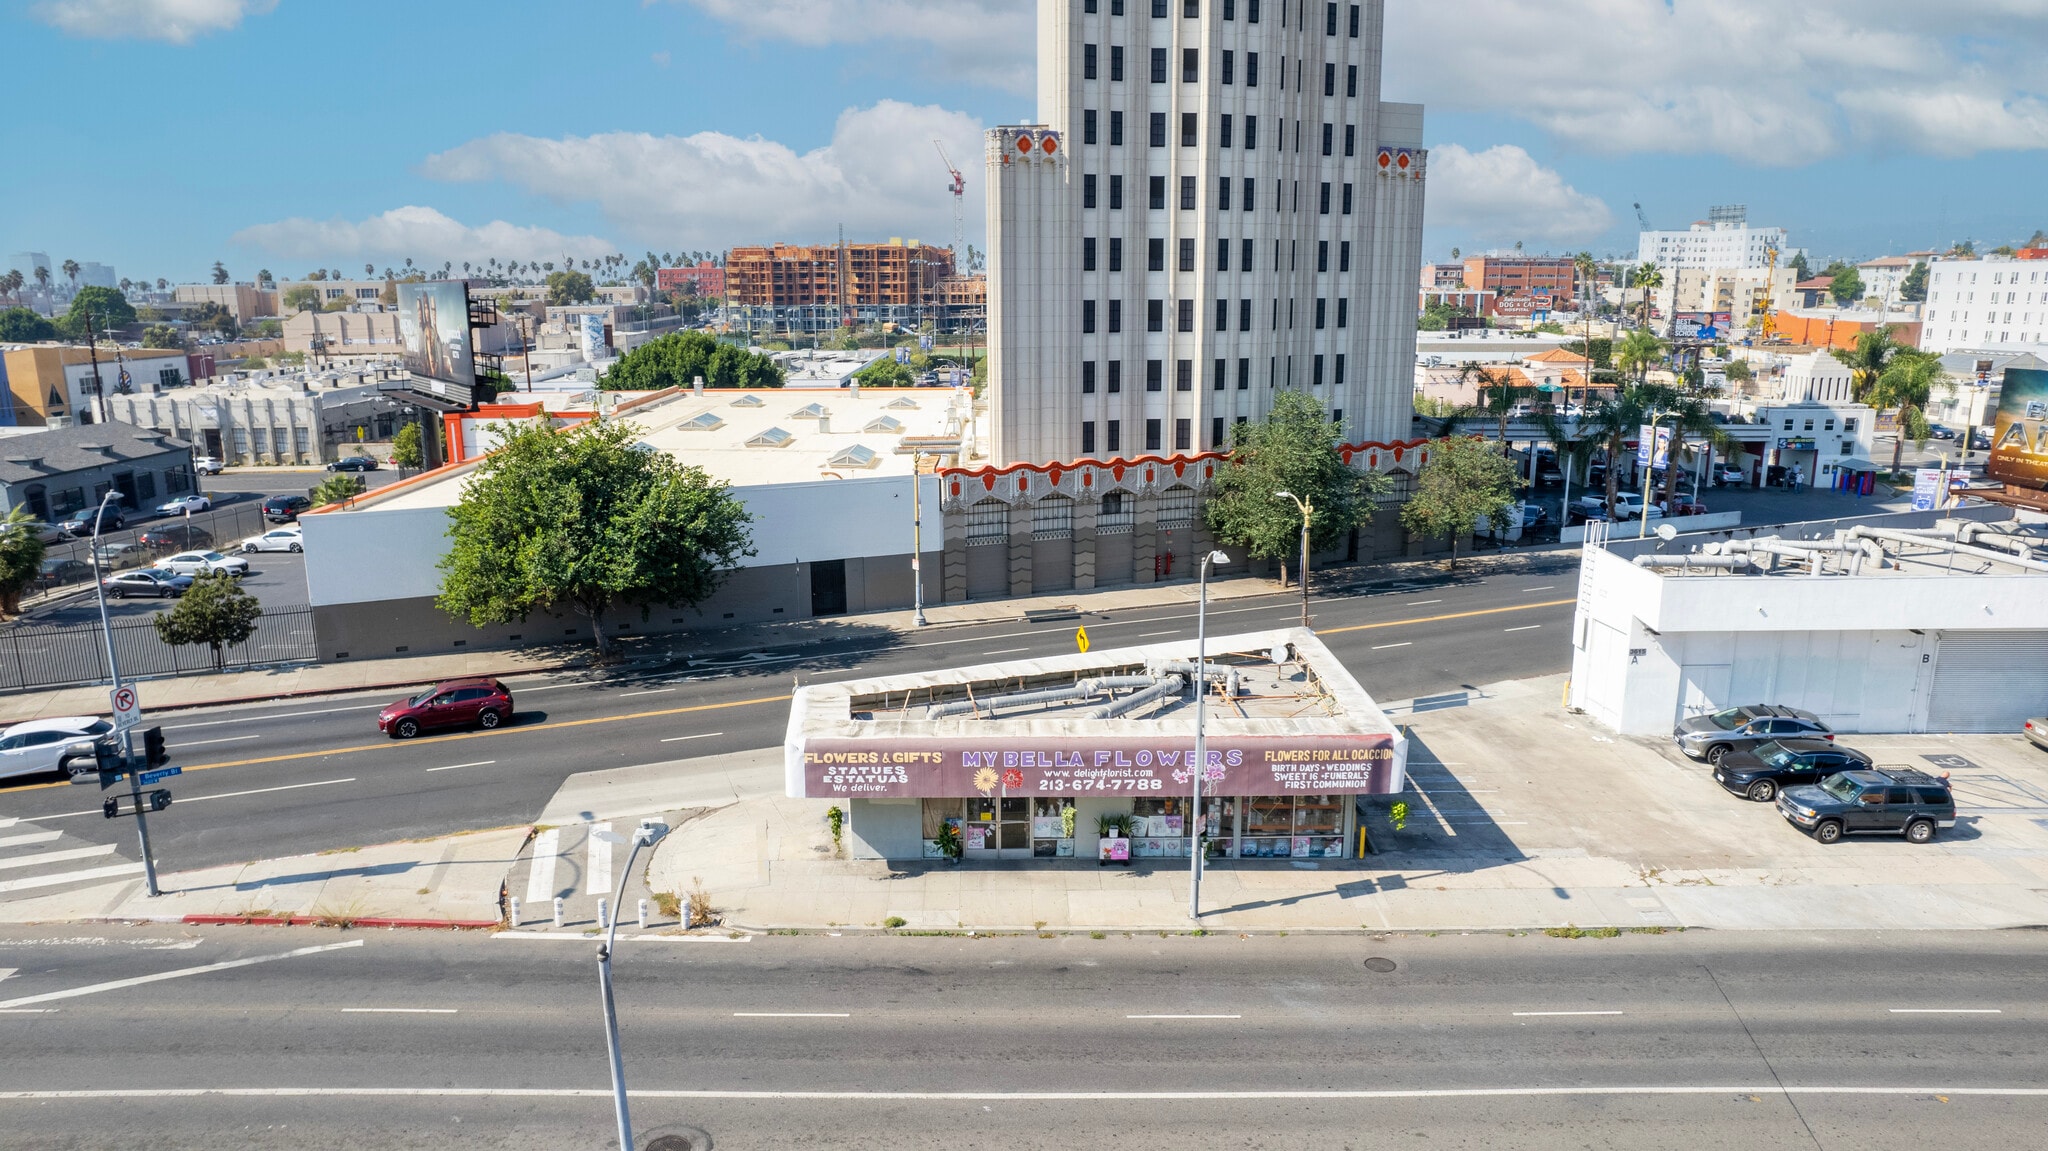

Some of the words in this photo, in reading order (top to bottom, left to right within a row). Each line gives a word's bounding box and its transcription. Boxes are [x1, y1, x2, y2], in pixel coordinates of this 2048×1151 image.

[1997, 455, 2015, 463] ONLY
[1631, 656, 1638, 664] A
[1922, 653, 1930, 663] B
[804, 752, 879, 764] FLOWERS
[882, 752, 892, 763] &
[892, 751, 942, 764] GIFTS
[962, 751, 998, 767] MY
[1003, 751, 1085, 767] BELLA
[1094, 749, 1243, 767] FLOWERS
[1264, 750, 1311, 762] FLOWERS
[1312, 750, 1330, 761] FOR
[1332, 750, 1350, 761] ALL
[828, 765, 906, 775] STATUES
[1271, 763, 1297, 772] BIRTH
[1299, 763, 1320, 772] DAYS
[1326, 763, 1373, 772] WEDDINGS
[823, 774, 909, 784] ESTATUAS
[1274, 772, 1306, 781] SWEET
[832, 783, 848, 792] We
[850, 783, 888, 792] deliver.
[1039, 779, 1163, 791] 213-674-7788
[1285, 780, 1311, 789] FIRST
[1313, 779, 1367, 789] COMMUNION
